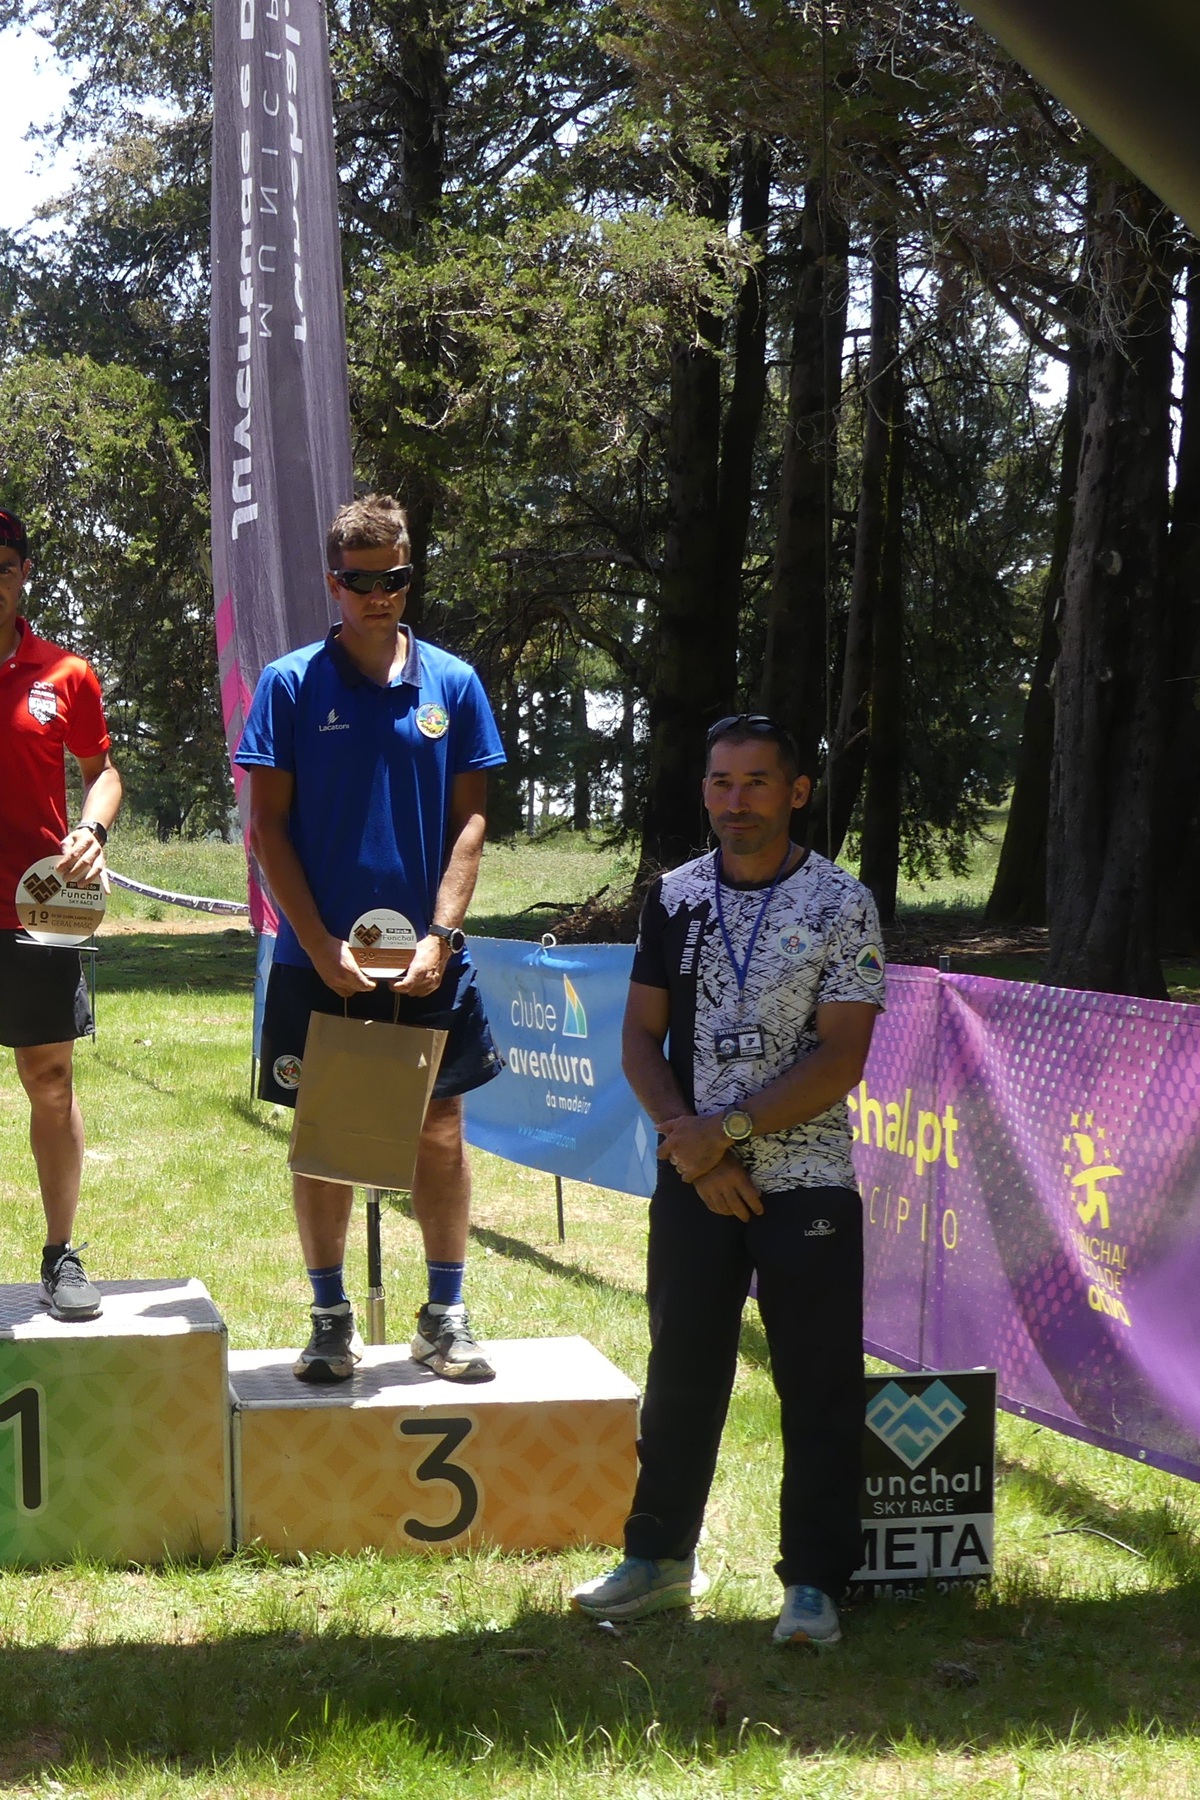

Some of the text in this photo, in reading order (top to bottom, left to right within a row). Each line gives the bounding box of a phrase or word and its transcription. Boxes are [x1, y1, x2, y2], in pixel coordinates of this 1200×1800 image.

[319, 723, 350, 732] Lacatoni
[60, 889, 102, 900] Funchal
[680, 920, 702, 976] TRAIN HARD
[510, 991, 557, 1032] clube
[509, 1042, 595, 1087] aventura
[545, 1089, 592, 1115] da madeira
[847, 1080, 960, 1176] hal.pt
[399, 1417, 478, 1542] 3
[865, 1465, 981, 1497] unchal
[873, 1499, 955, 1515] SKY RACE
